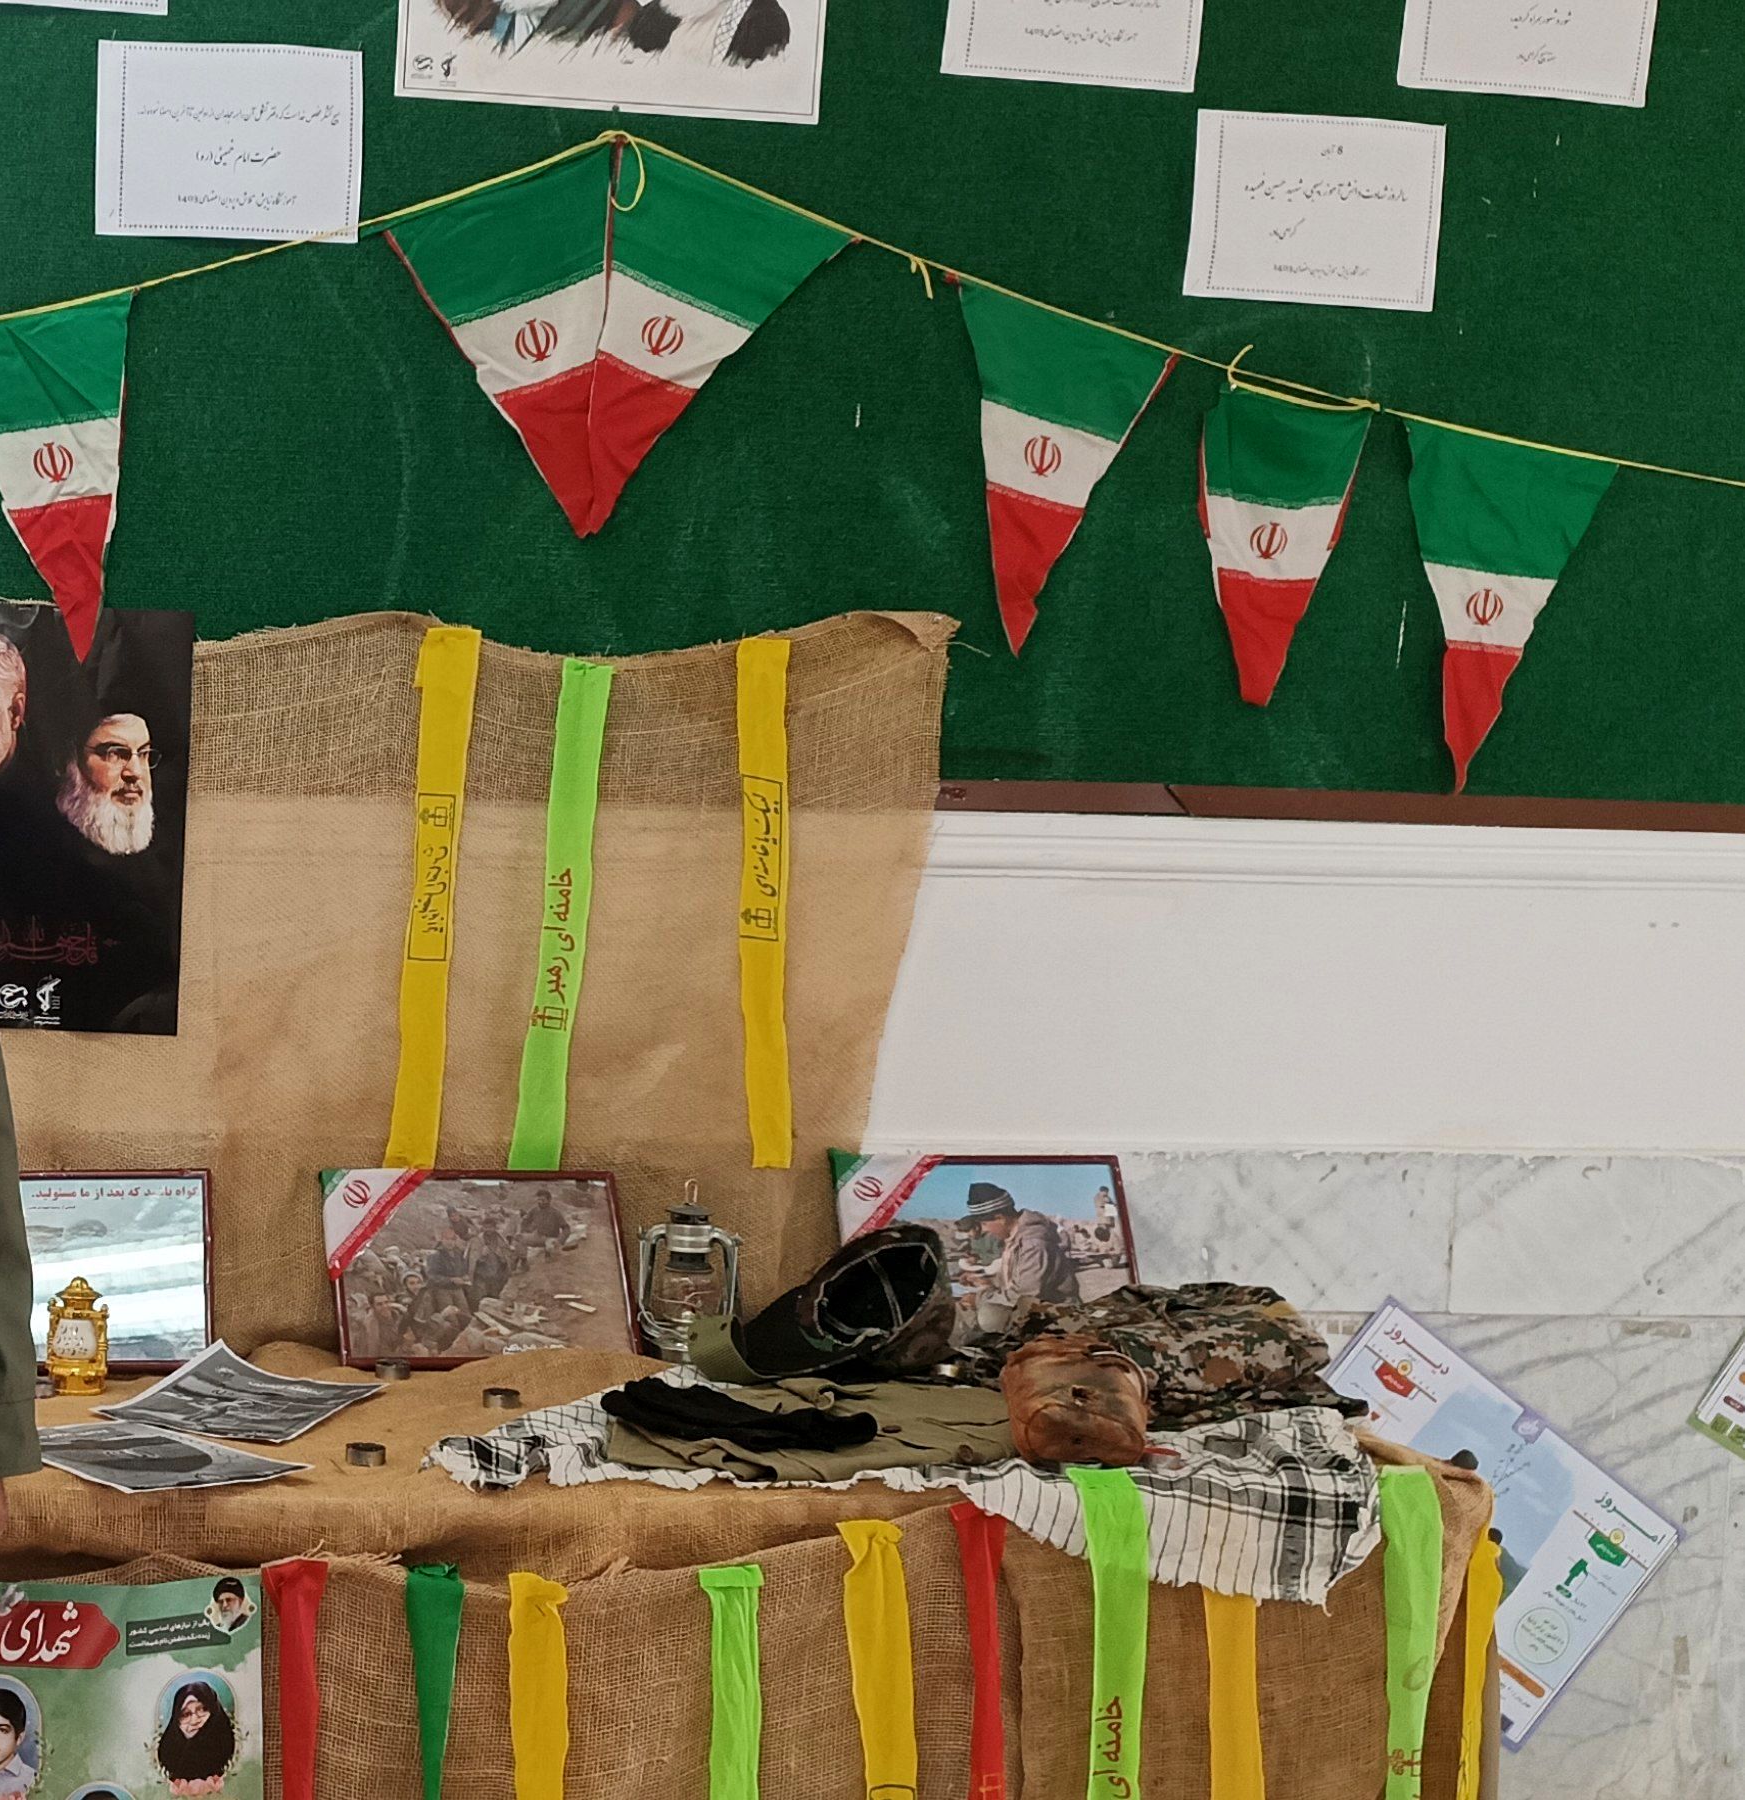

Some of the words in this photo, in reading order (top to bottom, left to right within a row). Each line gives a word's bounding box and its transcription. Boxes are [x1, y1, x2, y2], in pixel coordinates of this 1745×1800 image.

[545, 957, 570, 1005] رهبر
[80, 1187, 90, 1197] ما
[94, 1187, 104, 1200] از
[107, 1188, 125, 1198] بعد
[128, 1186, 141, 1197] که
[1383, 1321, 1450, 1377] دیروز
[1595, 1490, 1667, 1546] امروز
[0, 1601, 84, 1663] شهدای
[1094, 1695, 1123, 1763] خامنه
